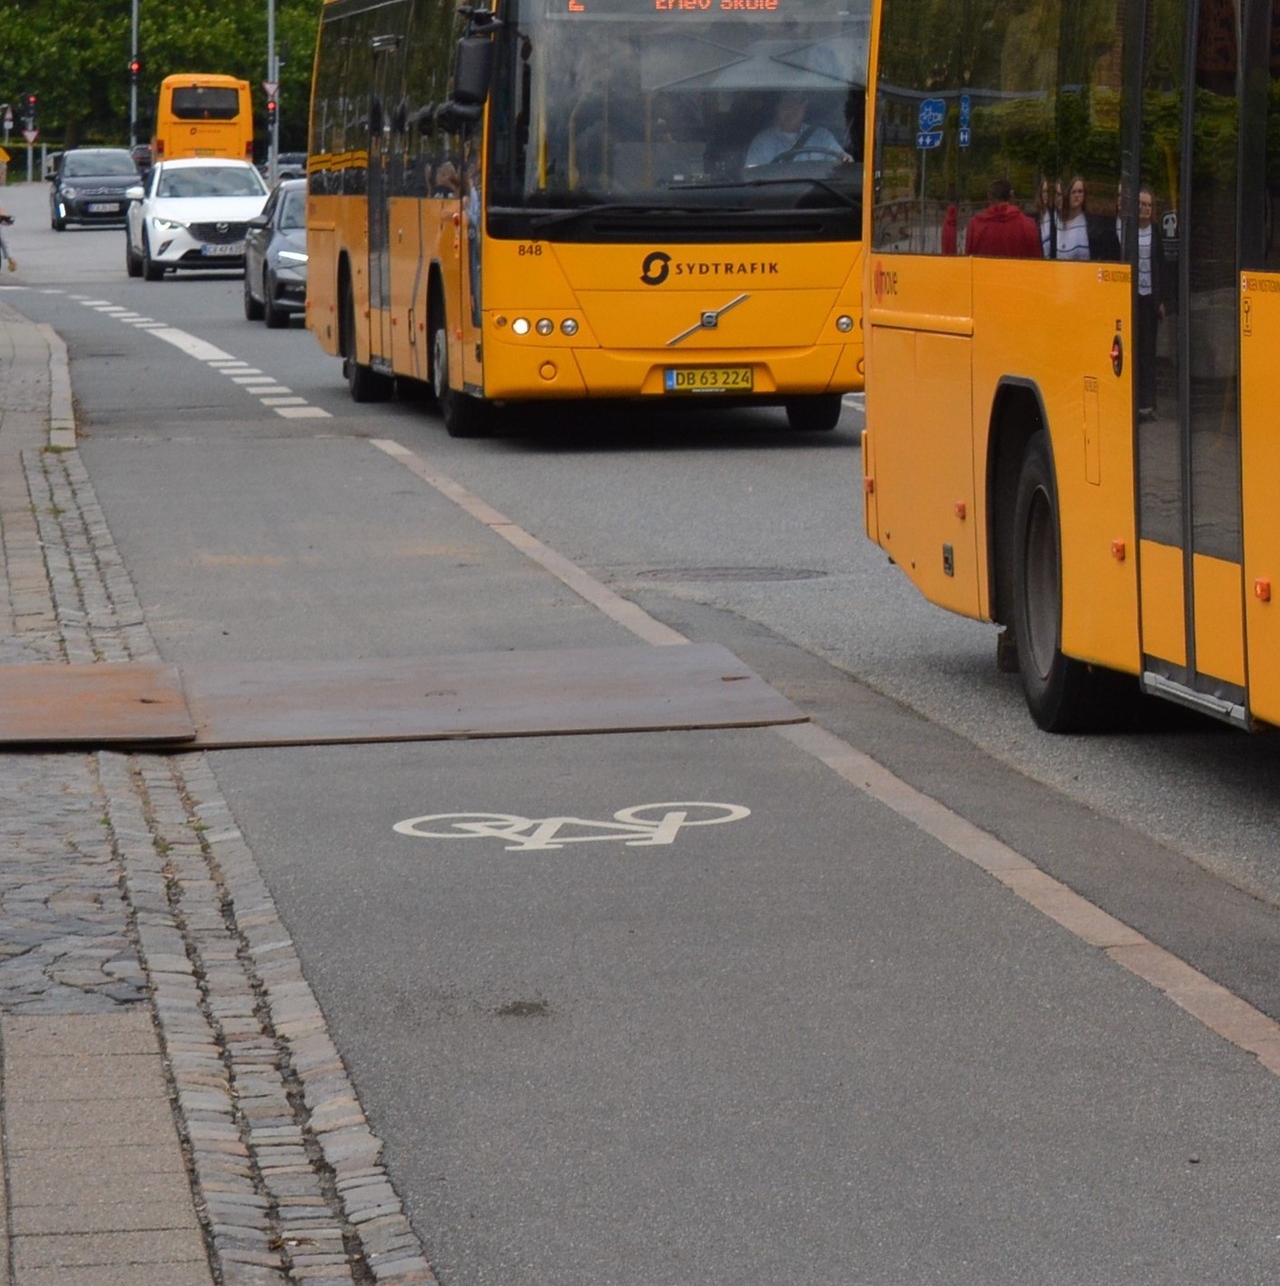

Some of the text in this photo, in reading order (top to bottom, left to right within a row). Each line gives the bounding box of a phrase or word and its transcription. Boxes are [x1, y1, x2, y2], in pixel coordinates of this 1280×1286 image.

[517, 244, 543, 257] 848
[675, 262, 780, 275] SYDTRAFIK
[675, 369, 750, 386] DB 63 224
